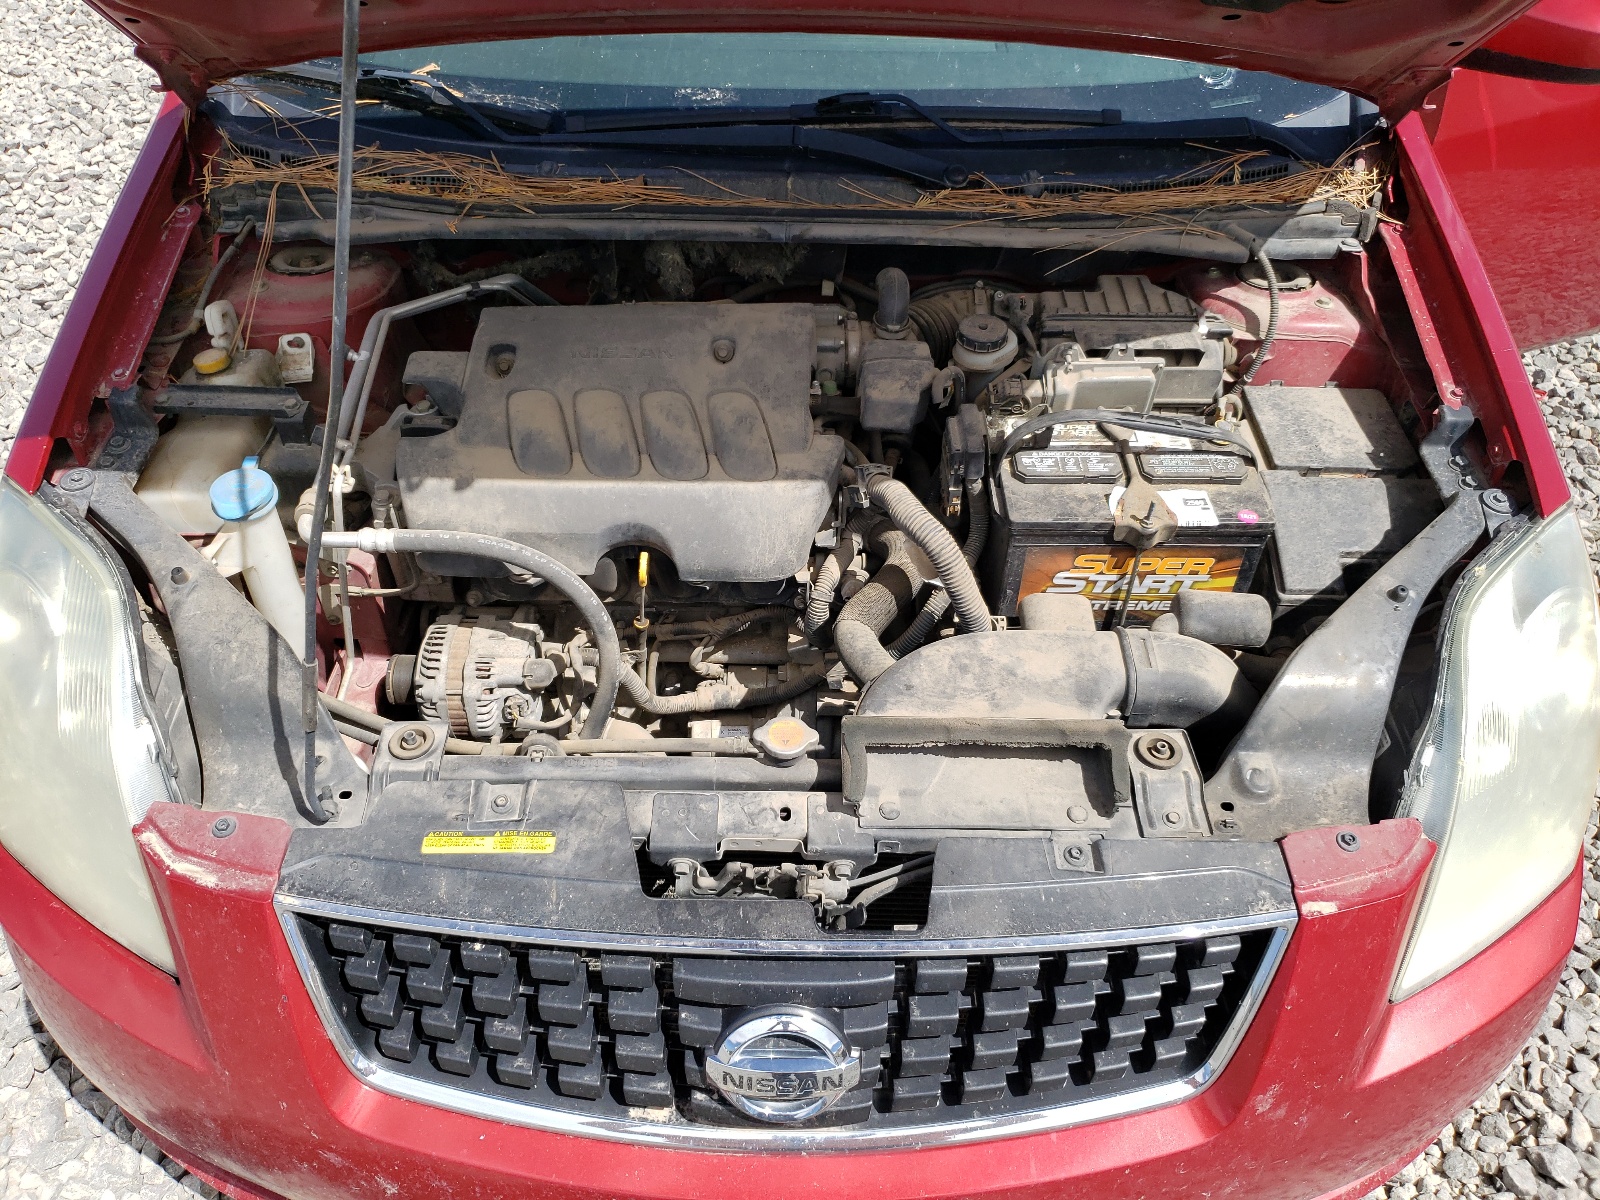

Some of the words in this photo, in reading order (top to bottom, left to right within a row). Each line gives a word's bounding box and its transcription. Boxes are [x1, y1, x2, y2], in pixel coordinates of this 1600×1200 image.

[1069, 554, 1216, 575] SUPER
[1045, 571, 1212, 594] START
[1091, 600, 1172, 611] TREME
[721, 1070, 844, 1096] NISSAN
